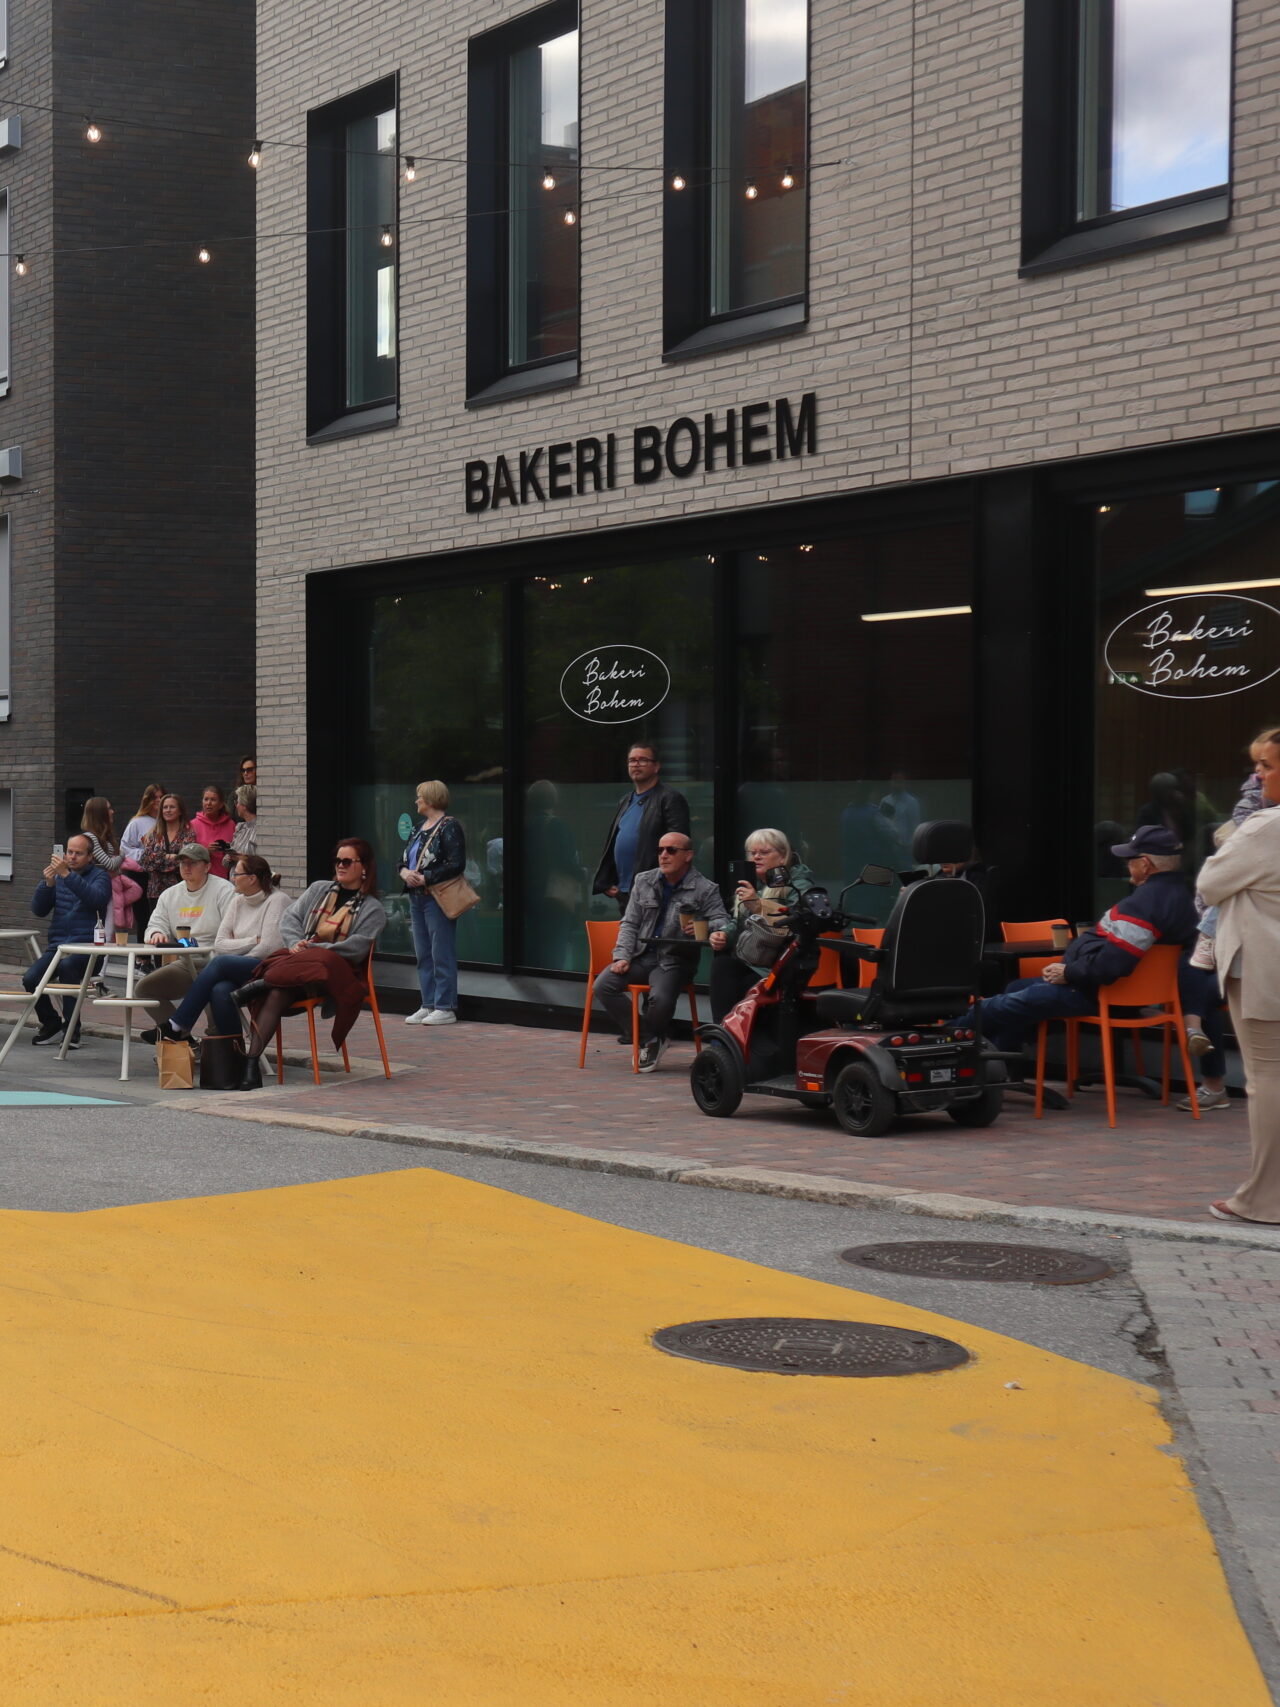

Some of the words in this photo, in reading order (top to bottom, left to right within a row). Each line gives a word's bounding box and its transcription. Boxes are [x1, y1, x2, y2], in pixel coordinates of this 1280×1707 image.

[465, 433, 616, 514] BAKERI
[634, 392, 817, 486] BOHEM
[1142, 611, 1254, 649] Bakeri
[582, 657, 646, 686] Bakeri
[1145, 649, 1250, 687] Bohem
[583, 685, 645, 715] Bohem
